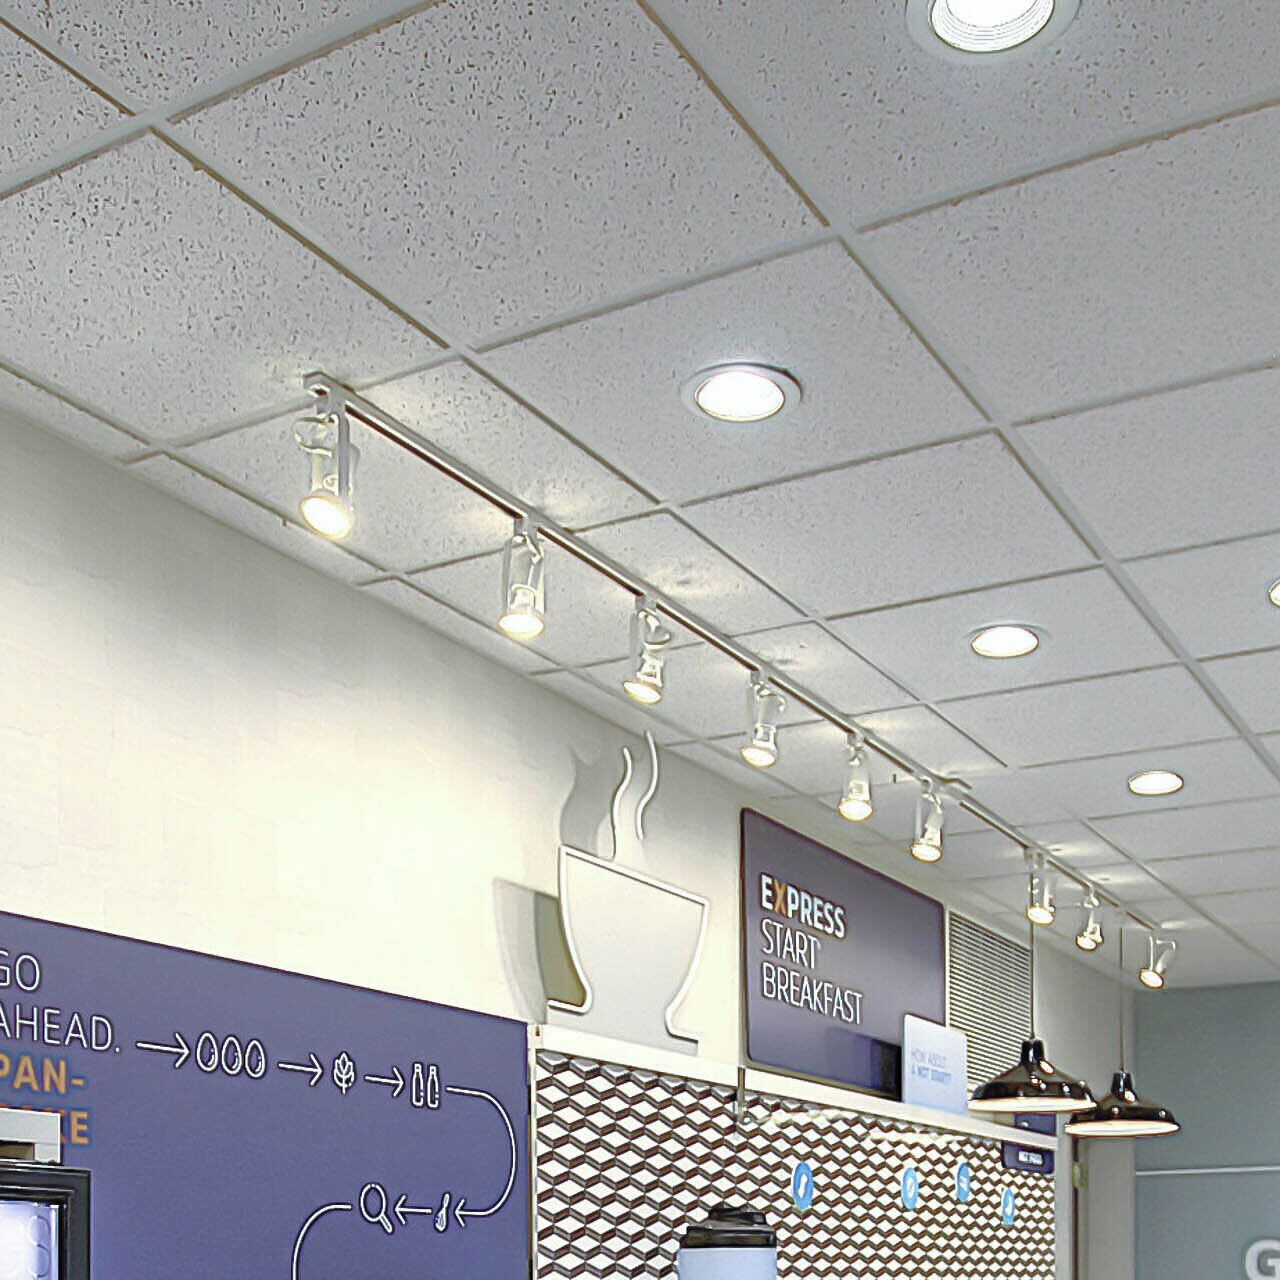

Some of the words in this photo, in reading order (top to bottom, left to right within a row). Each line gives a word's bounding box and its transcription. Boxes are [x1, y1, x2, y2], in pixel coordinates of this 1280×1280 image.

[760, 874, 846, 939] EXPRESS
[761, 918, 820, 970] START
[761, 962, 863, 1026] BREAKFAST
